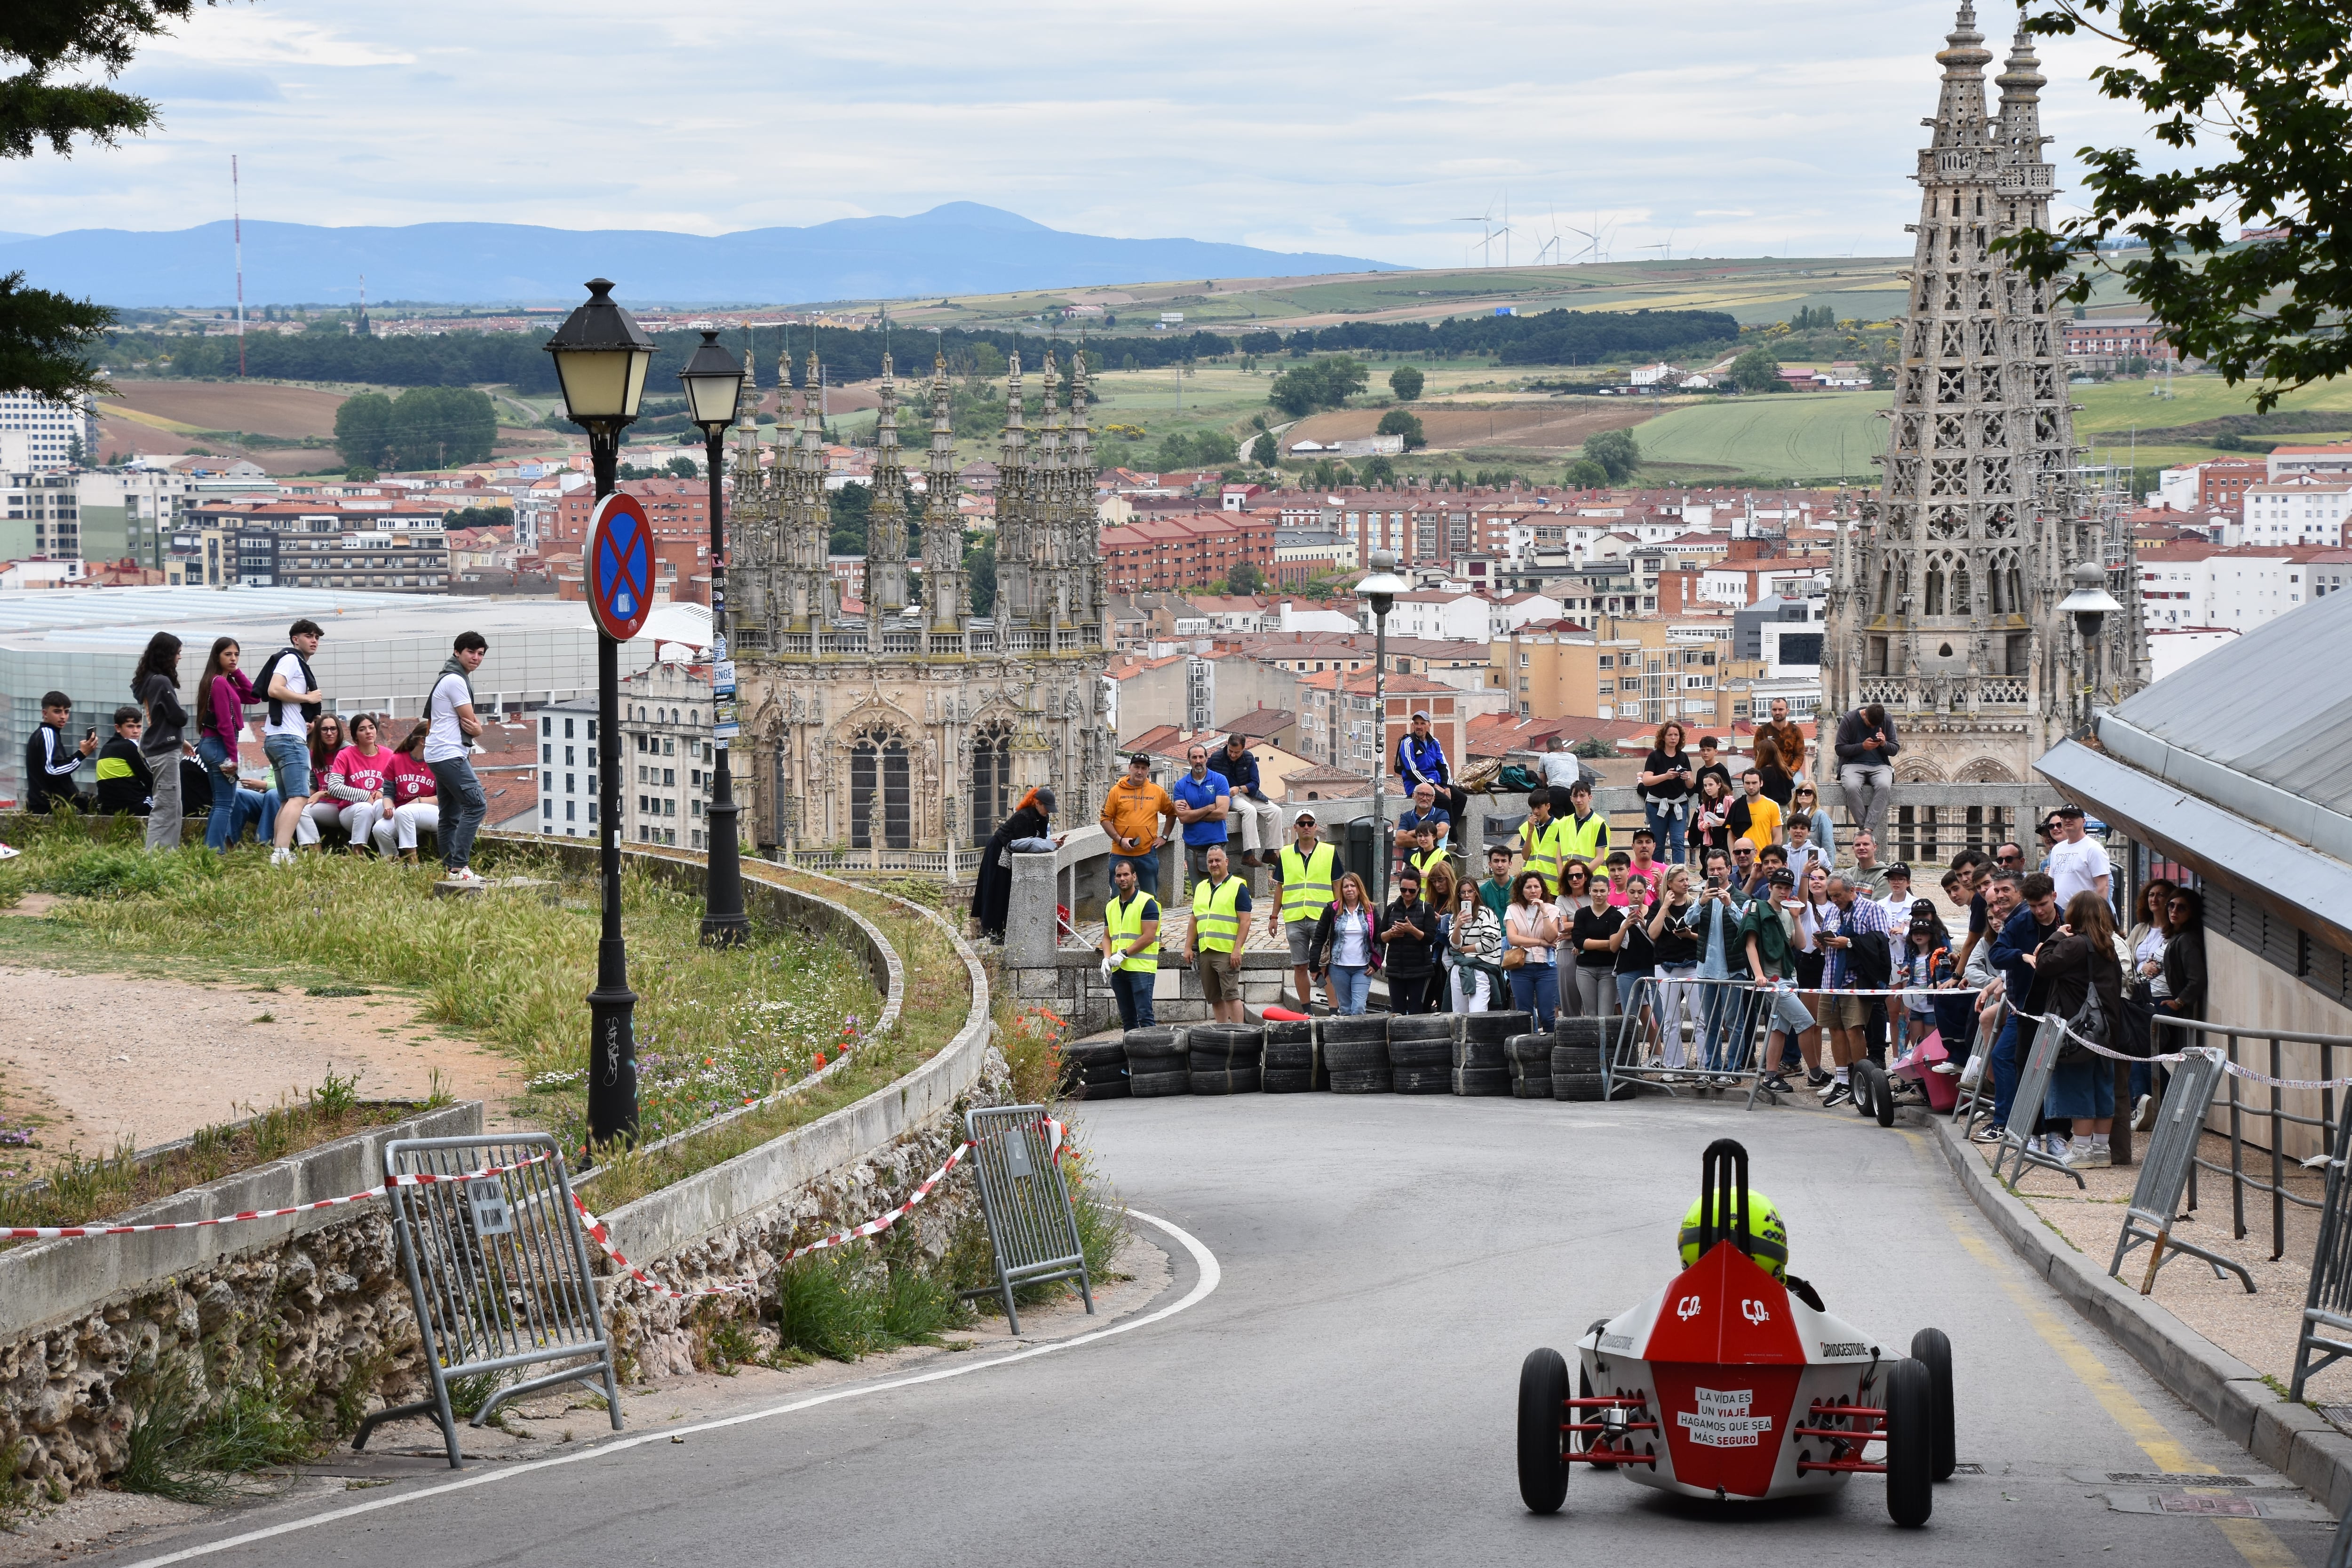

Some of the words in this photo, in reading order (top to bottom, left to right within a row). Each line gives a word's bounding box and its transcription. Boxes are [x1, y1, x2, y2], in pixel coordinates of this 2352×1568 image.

[713, 668, 732, 680] ENGE
[395, 774, 434, 788] PIONEROS
[481, 1208, 503, 1228] BURGOS
[1599, 1332, 1634, 1350] BRIDGESTONE
[1820, 1342, 1868, 1357] BRIDGESTONE
[1700, 1391, 1711, 1401] LA
[1714, 1394, 1735, 1404] VIDA
[1739, 1394, 1750, 1402] ES
[1701, 1405, 1714, 1416] UN
[1717, 1408, 1749, 1417] VIAJE,
[1681, 1415, 1725, 1431] HAGAMOS
[1729, 1422, 1748, 1431] QUE
[1752, 1421, 1771, 1430] SEA
[1694, 1432, 1714, 1443] MÁS
[1716, 1435, 1756, 1445] SEGURO
